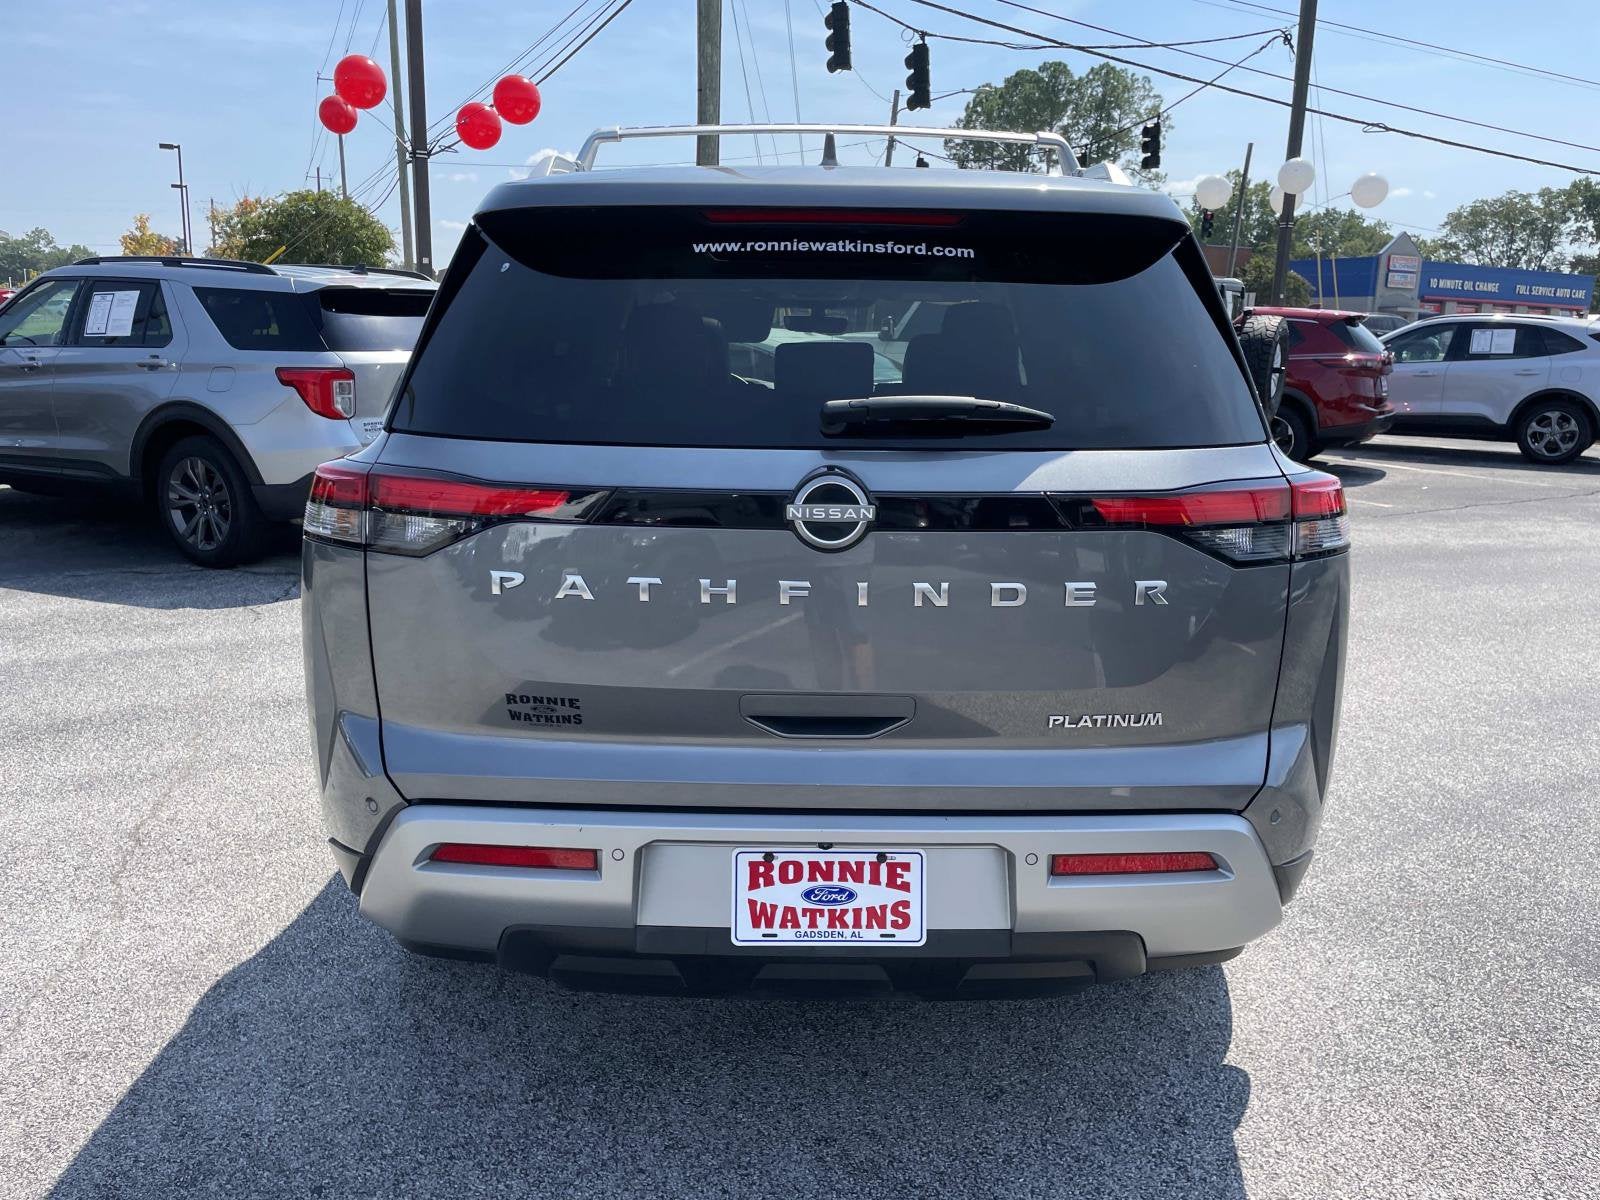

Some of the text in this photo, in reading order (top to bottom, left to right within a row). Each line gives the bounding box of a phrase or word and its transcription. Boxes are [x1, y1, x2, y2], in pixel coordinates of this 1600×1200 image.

[693, 239, 975, 258] www.ronniewatkinsford.com
[1430, 278, 1500, 293] 10 MINUTE OIL CHANGE
[1515, 284, 1587, 299] FULL SERVICE AUTO CARE
[789, 507, 873, 519] NISSAN
[490, 570, 1169, 607] PATHFINDER
[505, 693, 581, 710] RONNIE
[507, 709, 583, 725] WATKINS
[1048, 712, 1163, 729] PLATINUM
[748, 860, 911, 893] RONNIE
[810, 887, 850, 902] Ford
[748, 898, 911, 930] WATKINS
[794, 930, 864, 940] GADSDEN, AL
